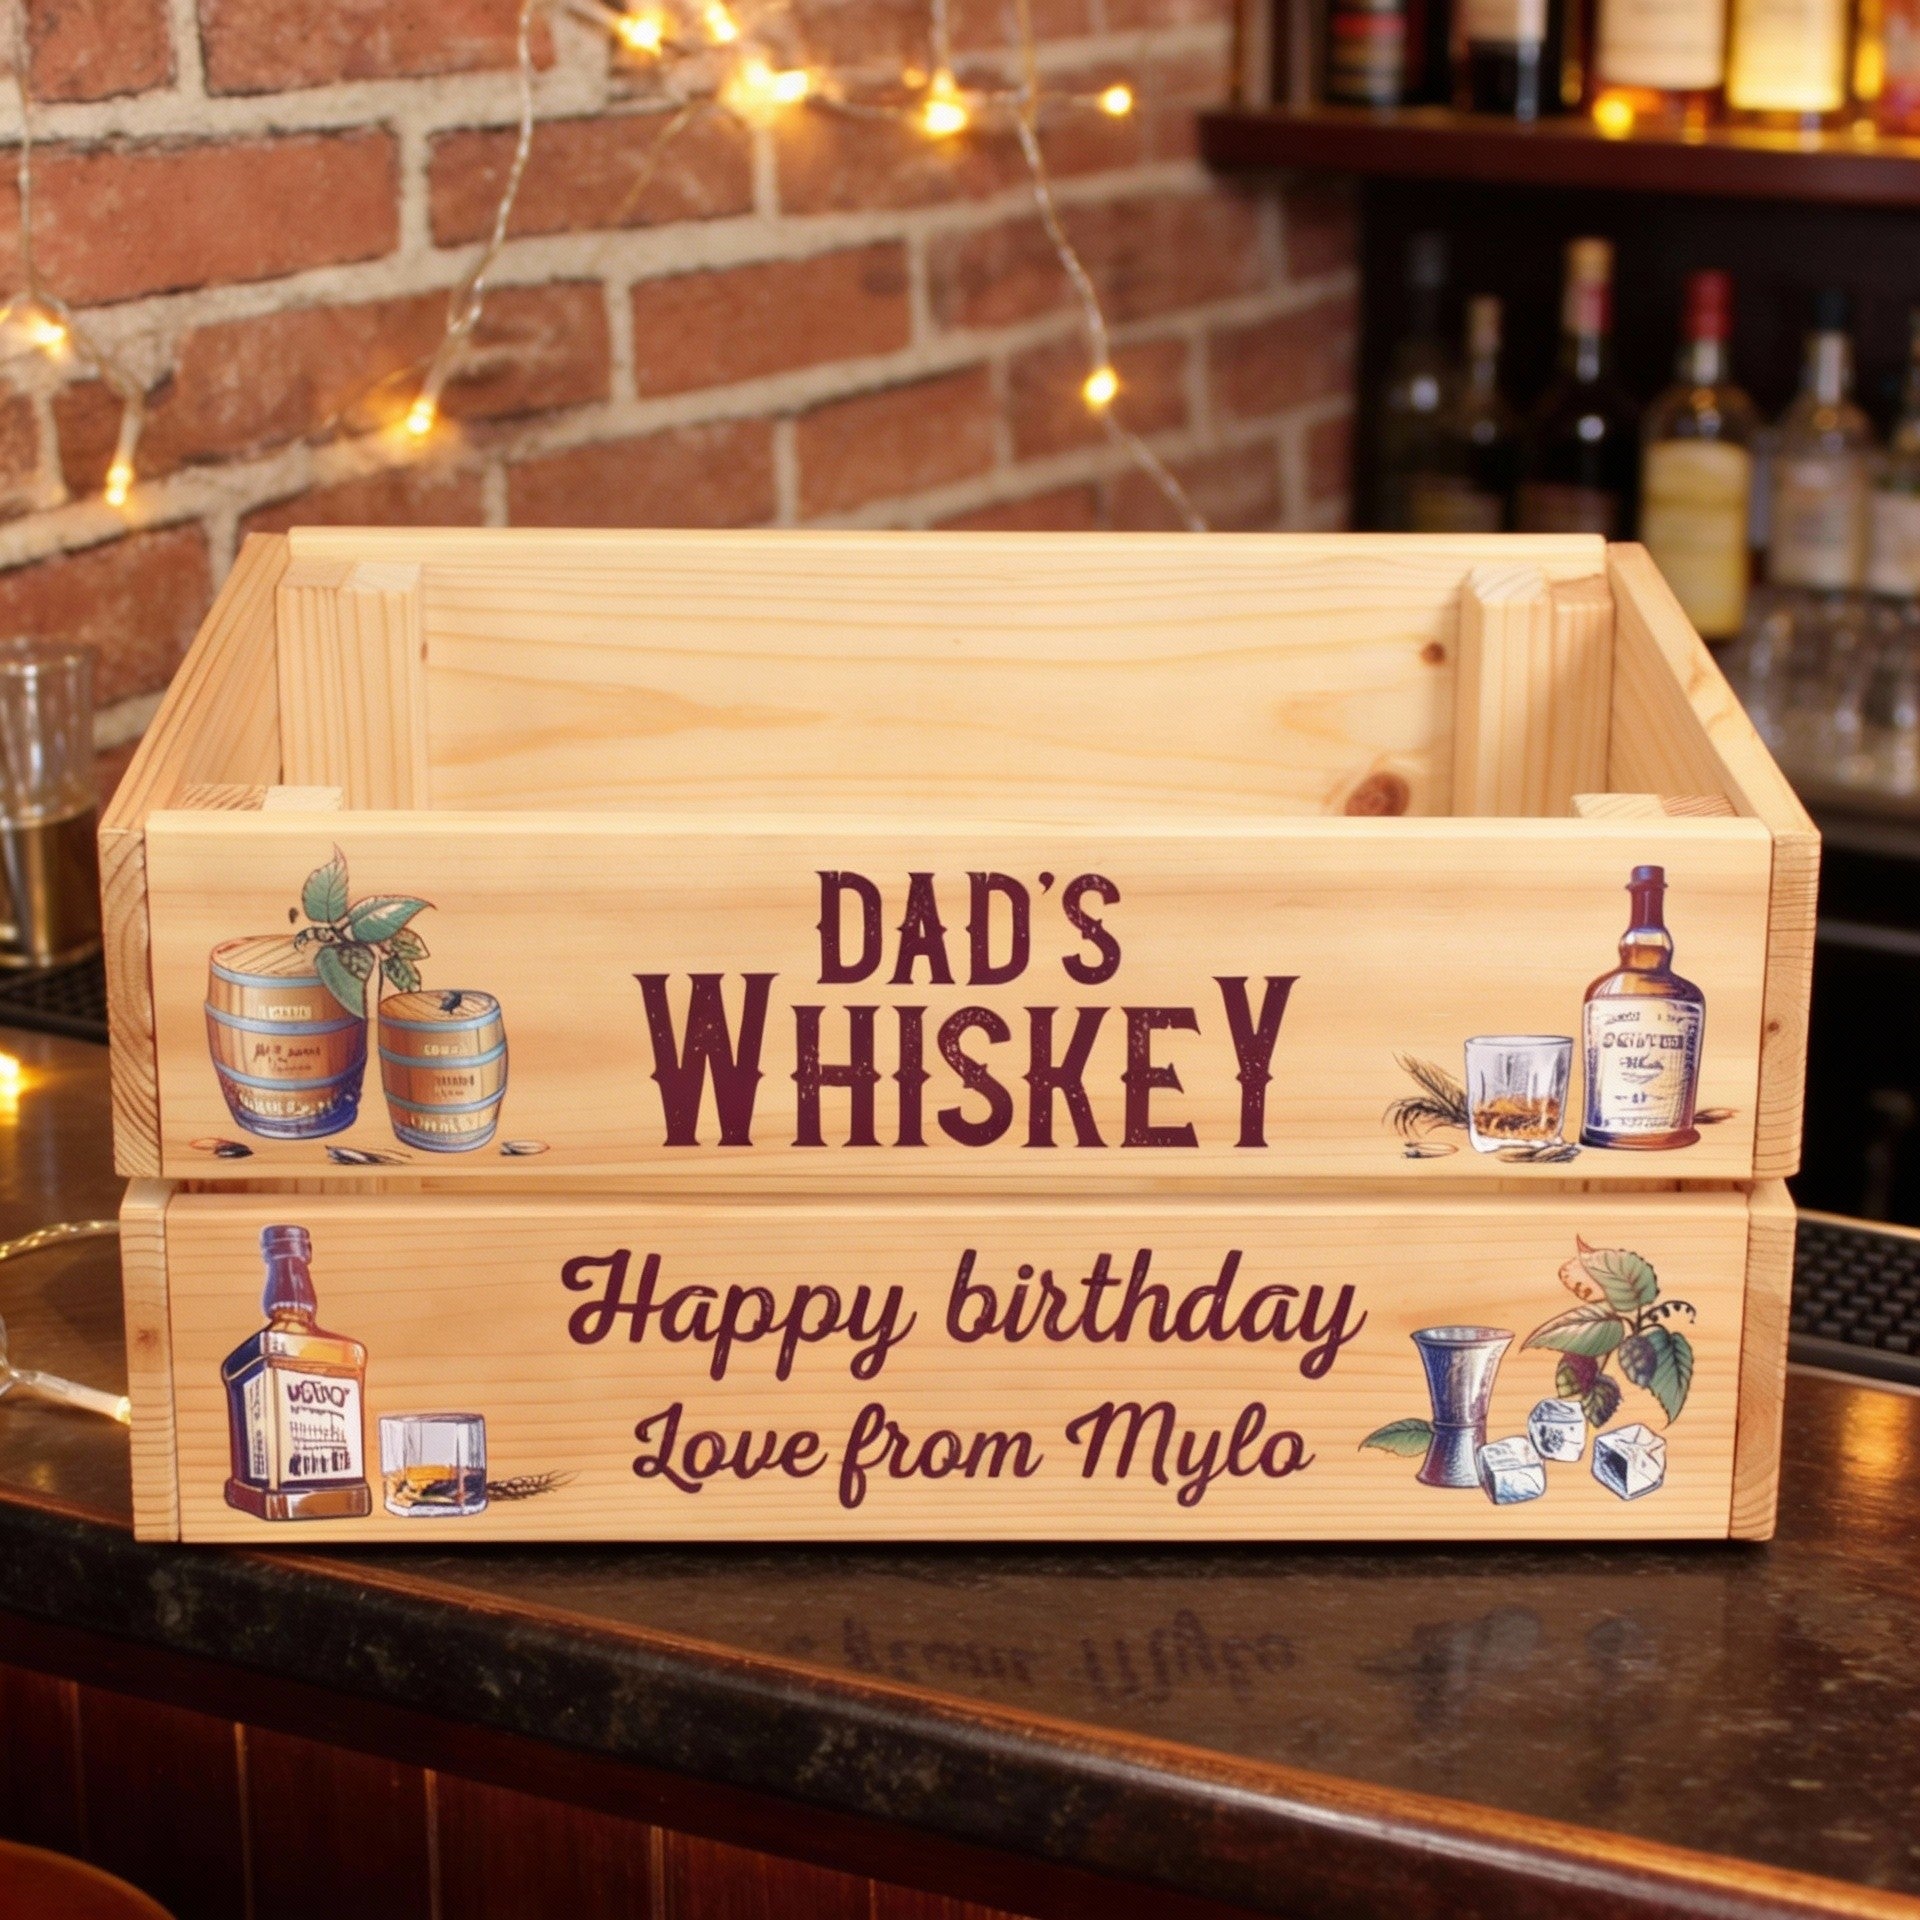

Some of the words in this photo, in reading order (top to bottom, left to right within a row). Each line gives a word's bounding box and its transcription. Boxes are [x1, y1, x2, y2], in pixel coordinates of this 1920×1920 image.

[817, 871, 1121, 985] DAD'S
[633, 973, 1299, 1148] WHISKEY
[561, 1249, 917, 1381] Happy
[946, 1249, 1367, 1379] birthday
[633, 1402, 828, 1493] Love
[839, 1403, 1043, 1509] from
[1065, 1402, 1315, 1507] Mylo
